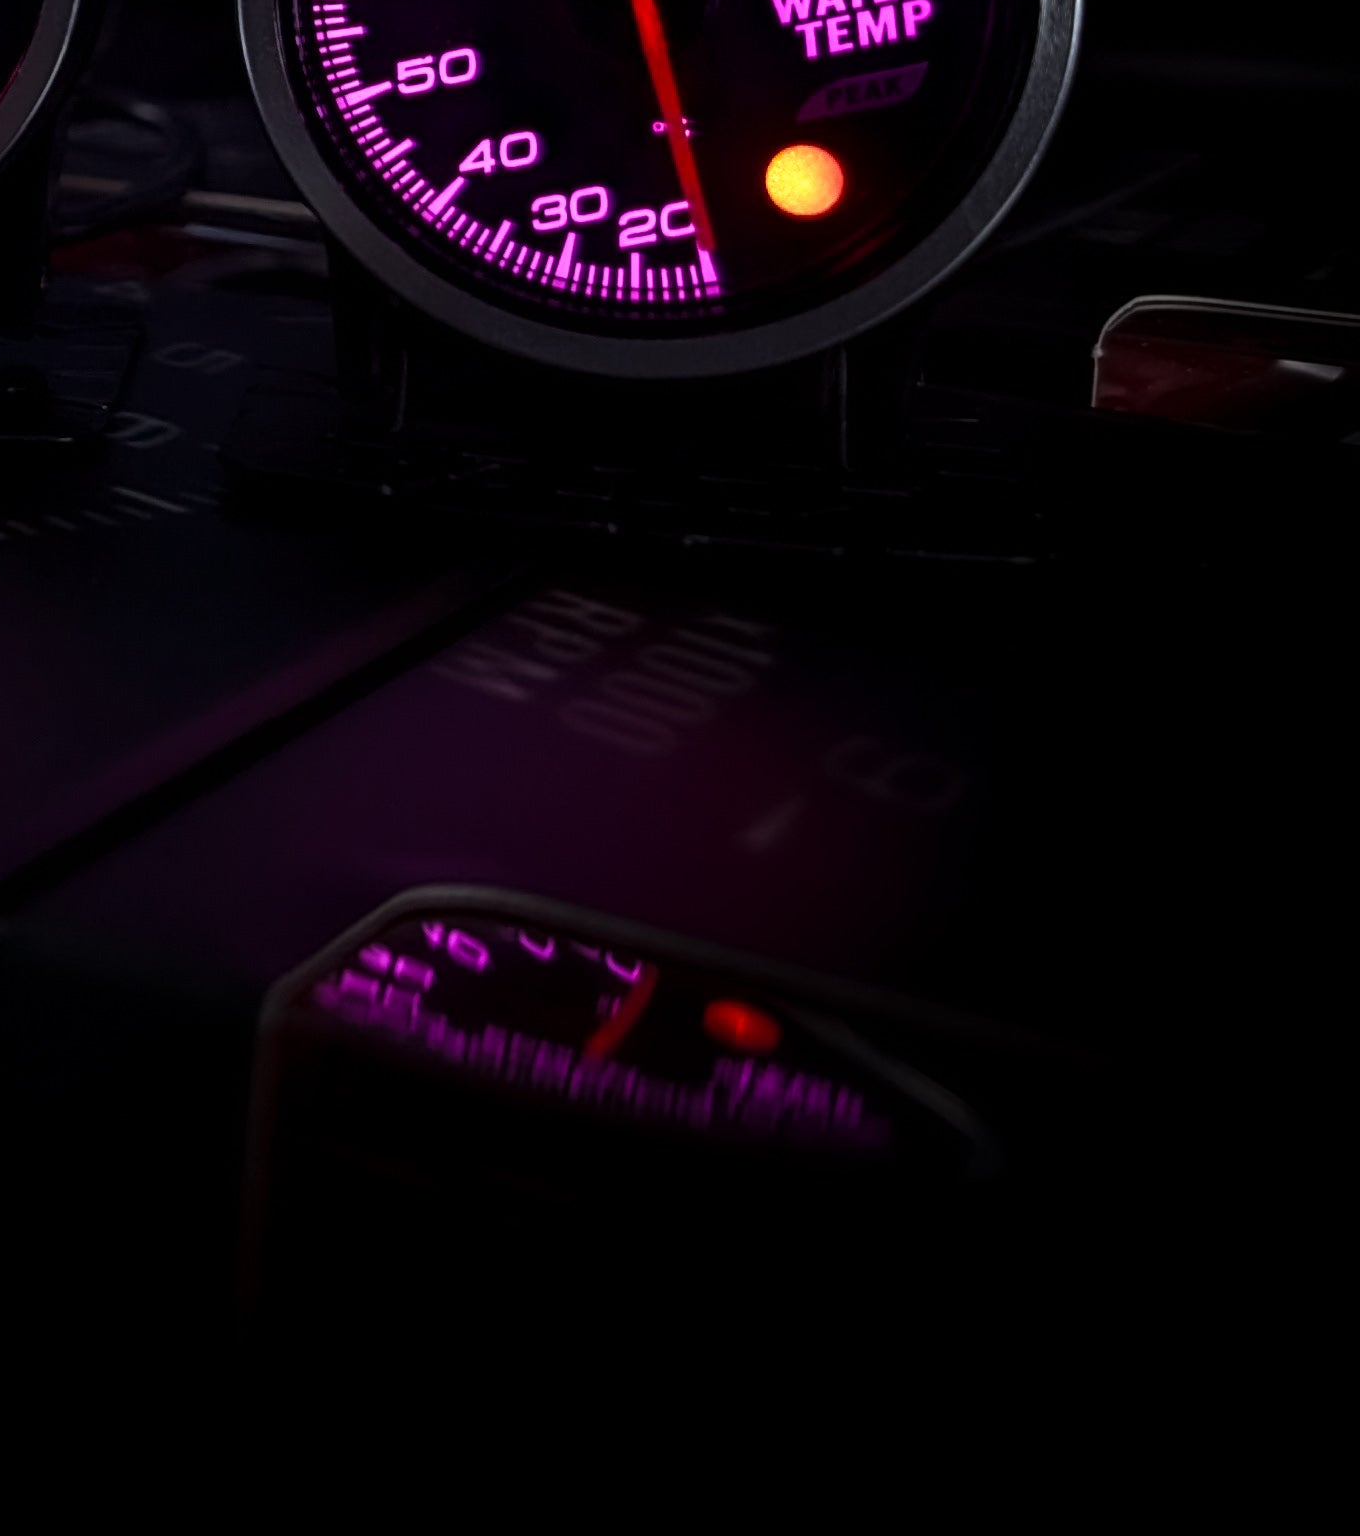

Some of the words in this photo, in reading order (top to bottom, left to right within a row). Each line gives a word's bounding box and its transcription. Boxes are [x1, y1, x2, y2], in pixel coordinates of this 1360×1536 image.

[395, 48, 478, 96] 50
[458, 131, 541, 176] 40
[532, 186, 610, 234] 30
[617, 201, 695, 248] 20
